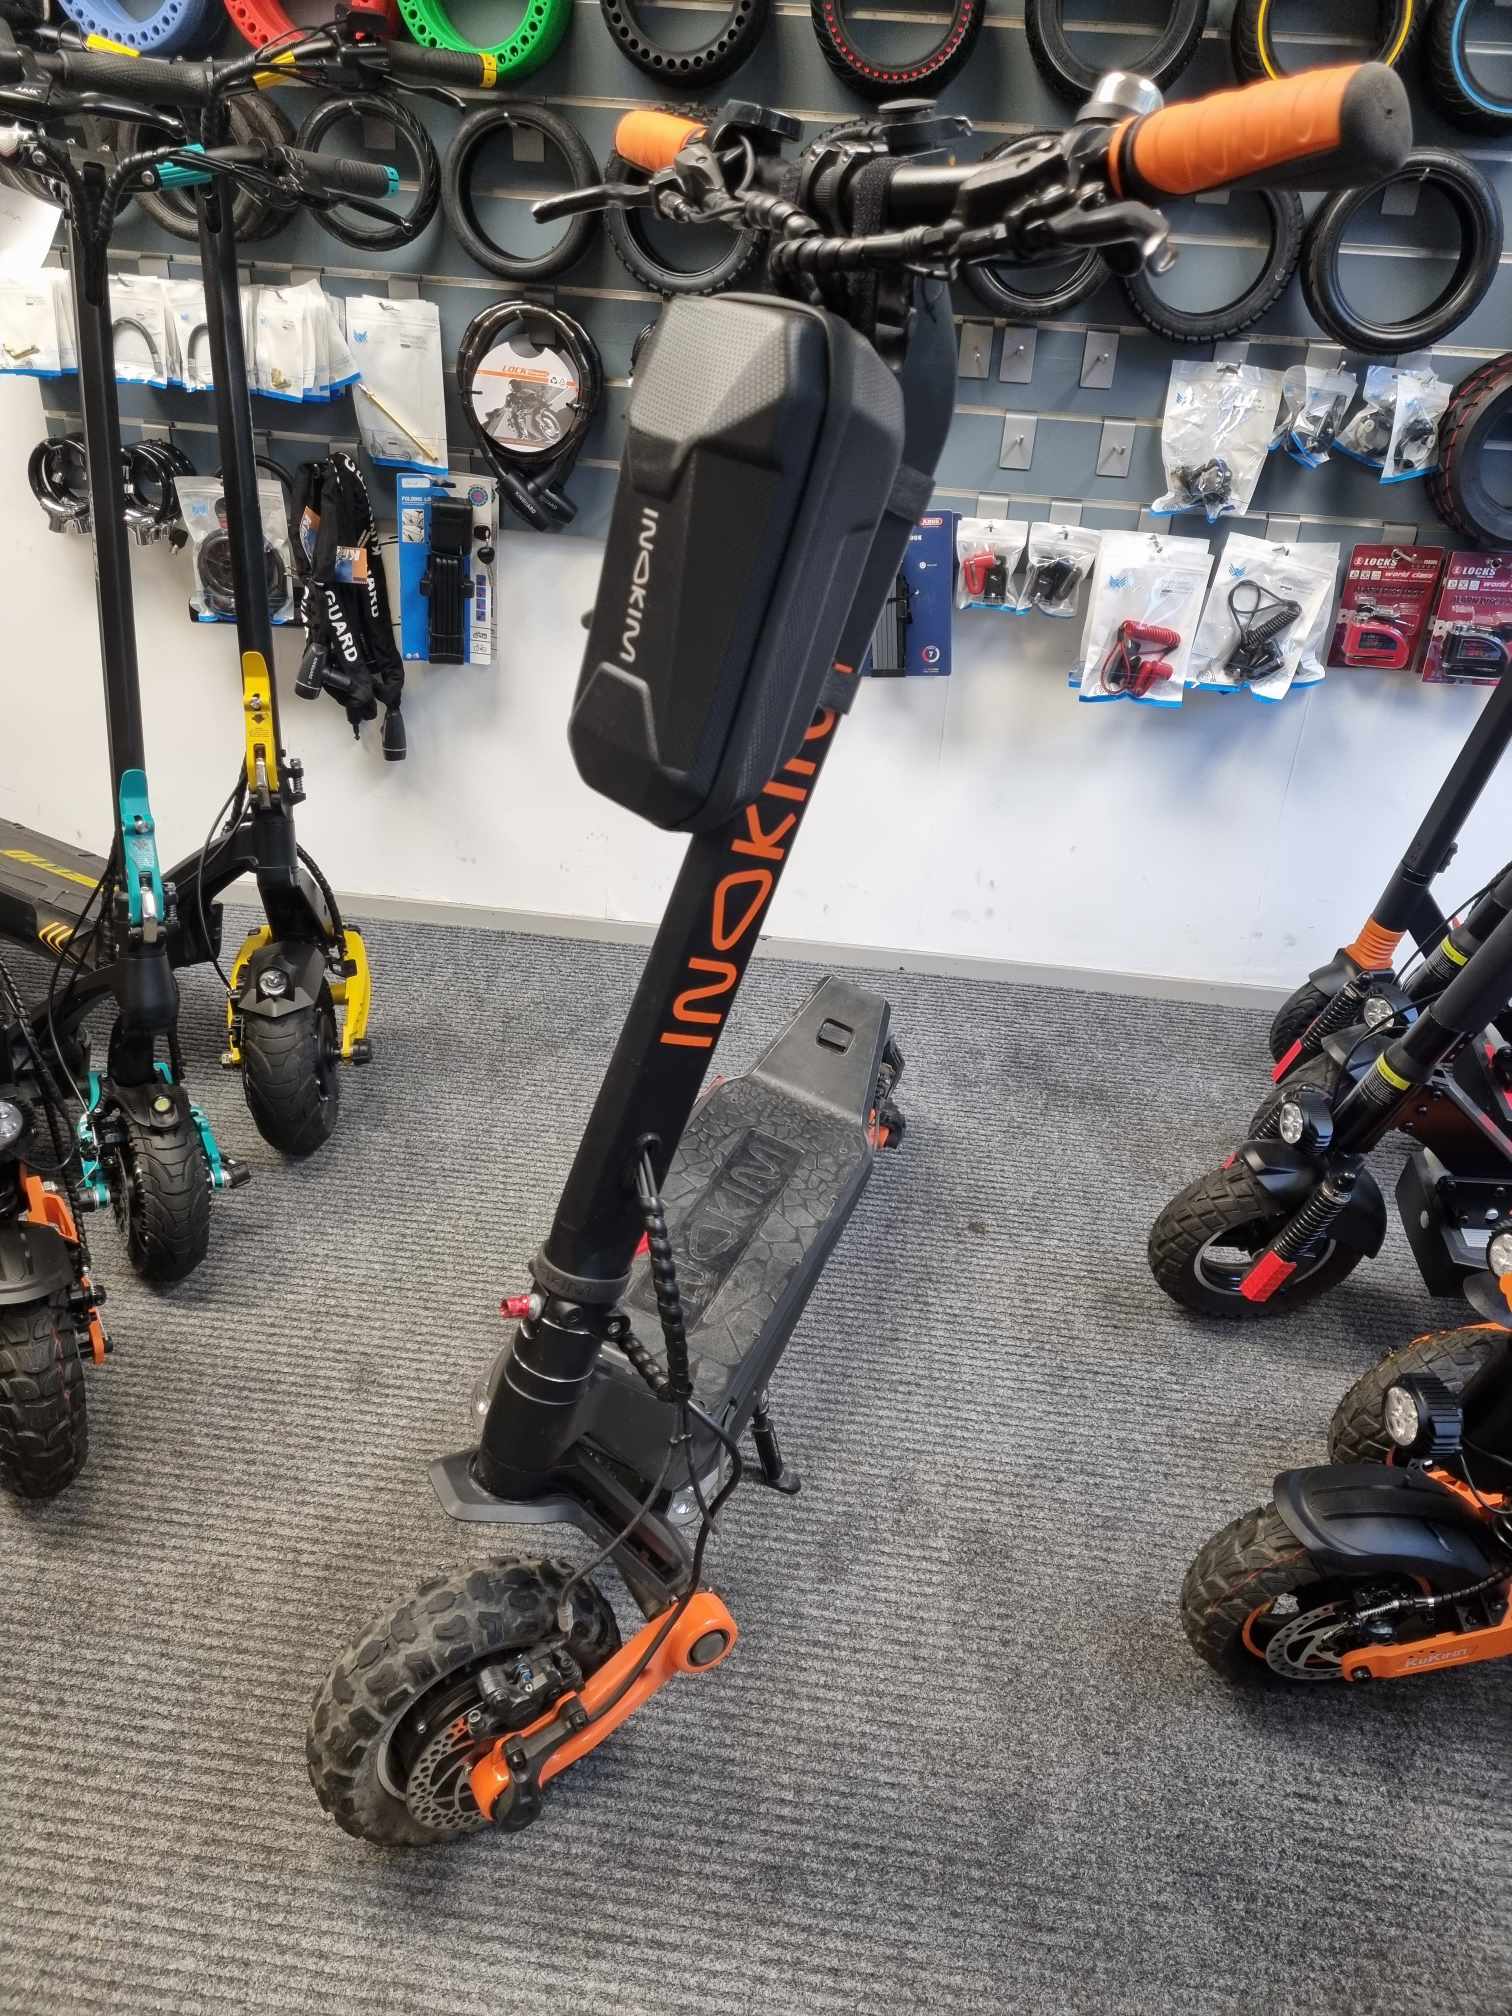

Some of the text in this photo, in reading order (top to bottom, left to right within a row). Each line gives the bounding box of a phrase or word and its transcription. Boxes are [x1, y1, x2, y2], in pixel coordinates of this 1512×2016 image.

[1363, 557, 1398, 567] LOCKS
[1462, 566, 1497, 576] LOCKS
[620, 507, 660, 664] INOKIM
[325, 590, 358, 662] GUARD
